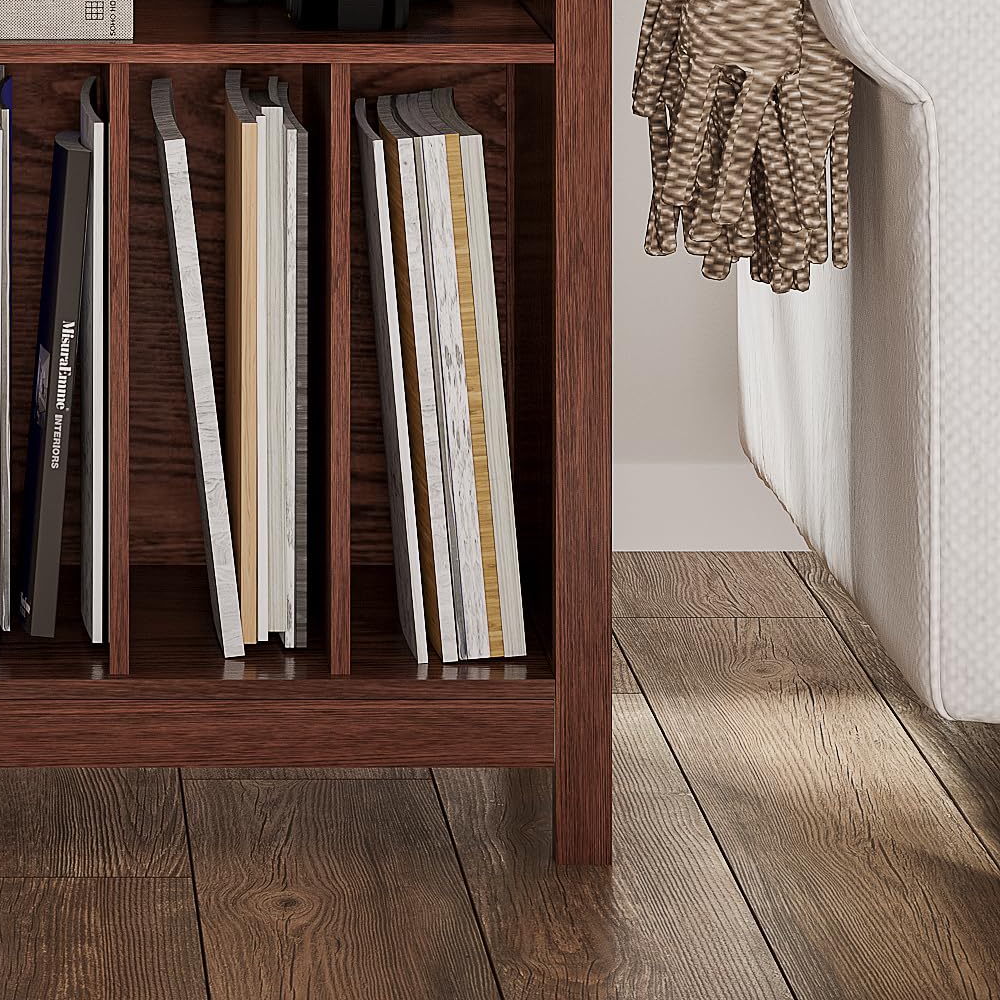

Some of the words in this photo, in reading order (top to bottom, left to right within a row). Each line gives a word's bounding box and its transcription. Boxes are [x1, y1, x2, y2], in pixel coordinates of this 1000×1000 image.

[109, 13, 117, 37] SOHO
[56, 320, 76, 410] MisuraEmme
[51, 414, 64, 469] INTERIORS
